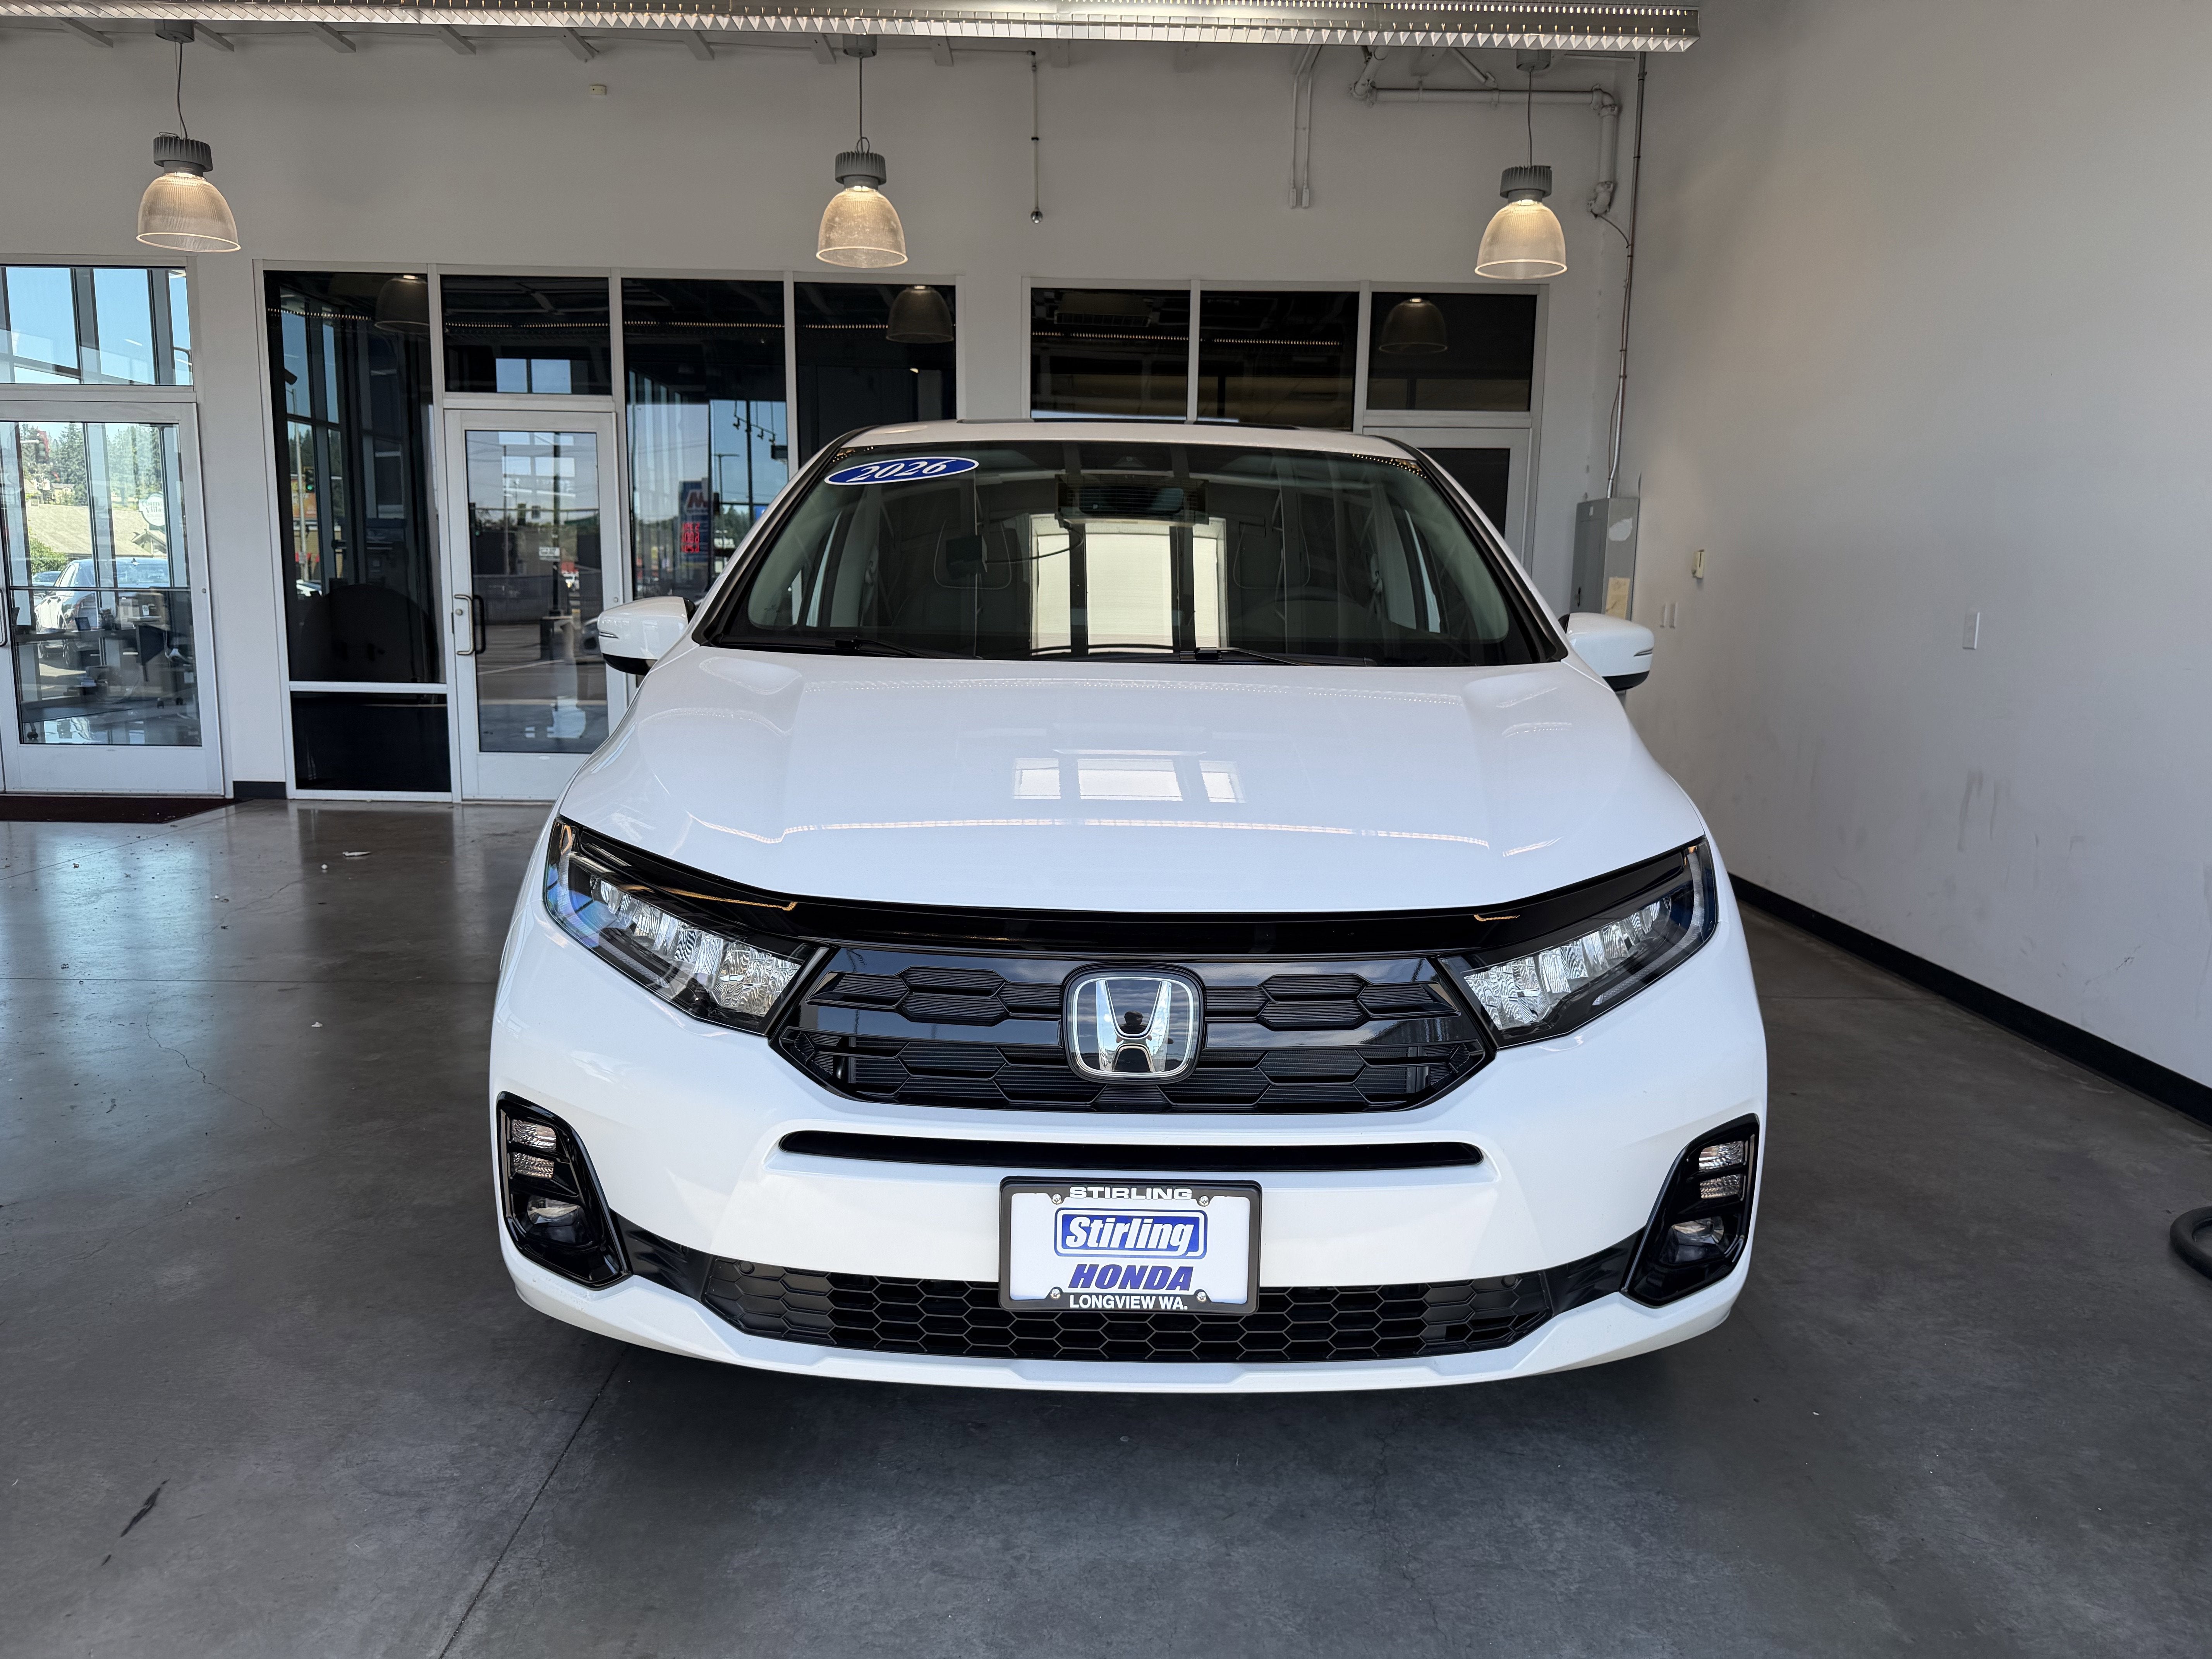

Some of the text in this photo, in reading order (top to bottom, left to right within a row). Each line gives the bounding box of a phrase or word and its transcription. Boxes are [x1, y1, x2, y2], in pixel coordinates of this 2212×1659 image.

[846, 459, 957, 483] 2026
[1069, 1187, 1193, 1200] STIRLING
[1065, 1216, 1194, 1256] Stirling
[1068, 1263, 1194, 1291] HONDA
[1069, 1294, 1188, 1310] LONGVIEW WA.
